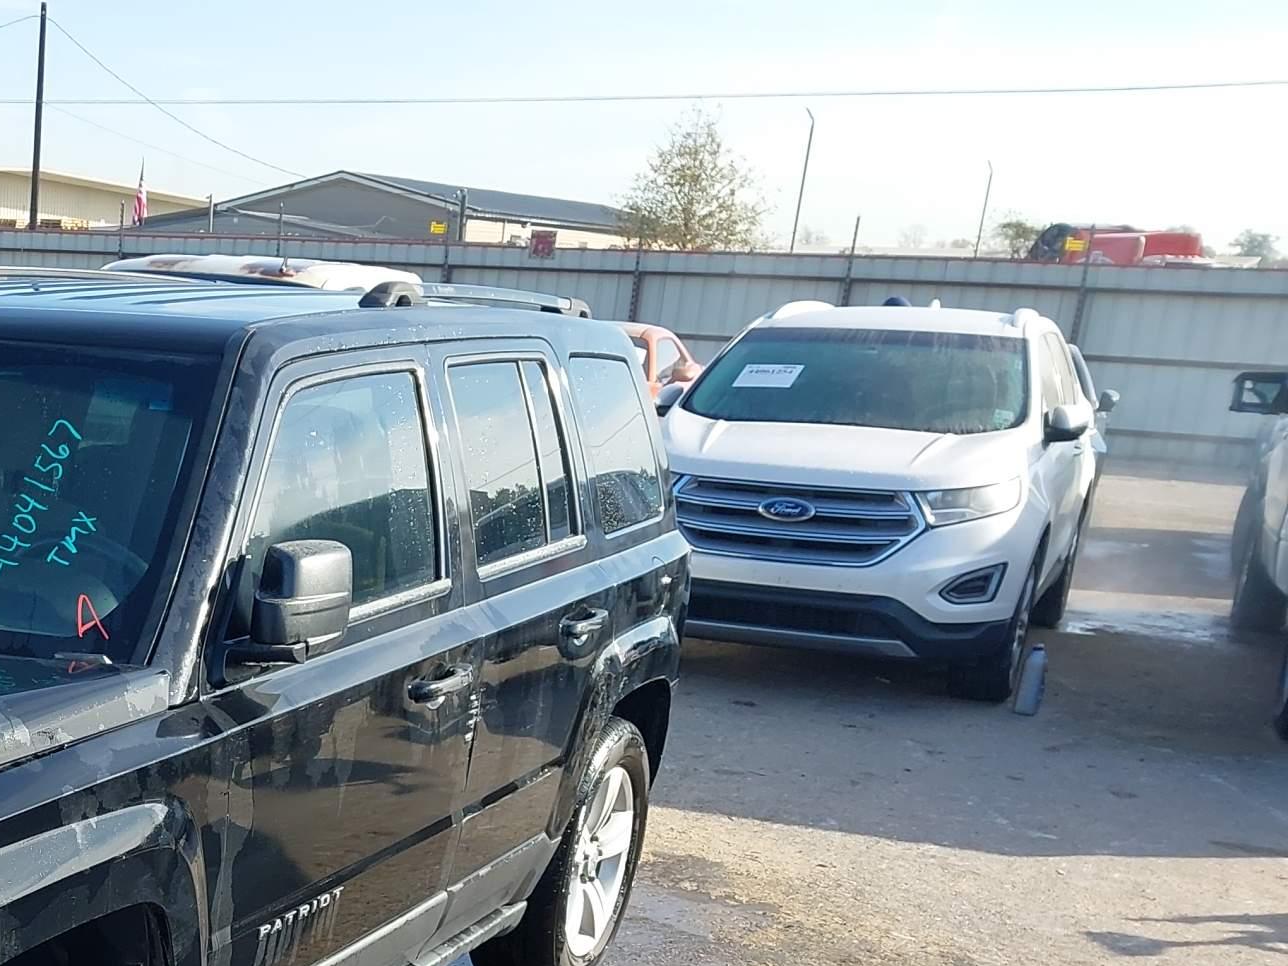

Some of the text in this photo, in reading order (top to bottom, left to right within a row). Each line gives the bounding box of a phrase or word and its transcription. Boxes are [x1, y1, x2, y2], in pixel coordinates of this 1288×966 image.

[770, 502, 802, 515] Ford
[47, 511, 97, 566] TMX
[76, 593, 110, 641] A
[258, 886, 345, 940] PATRIOT
